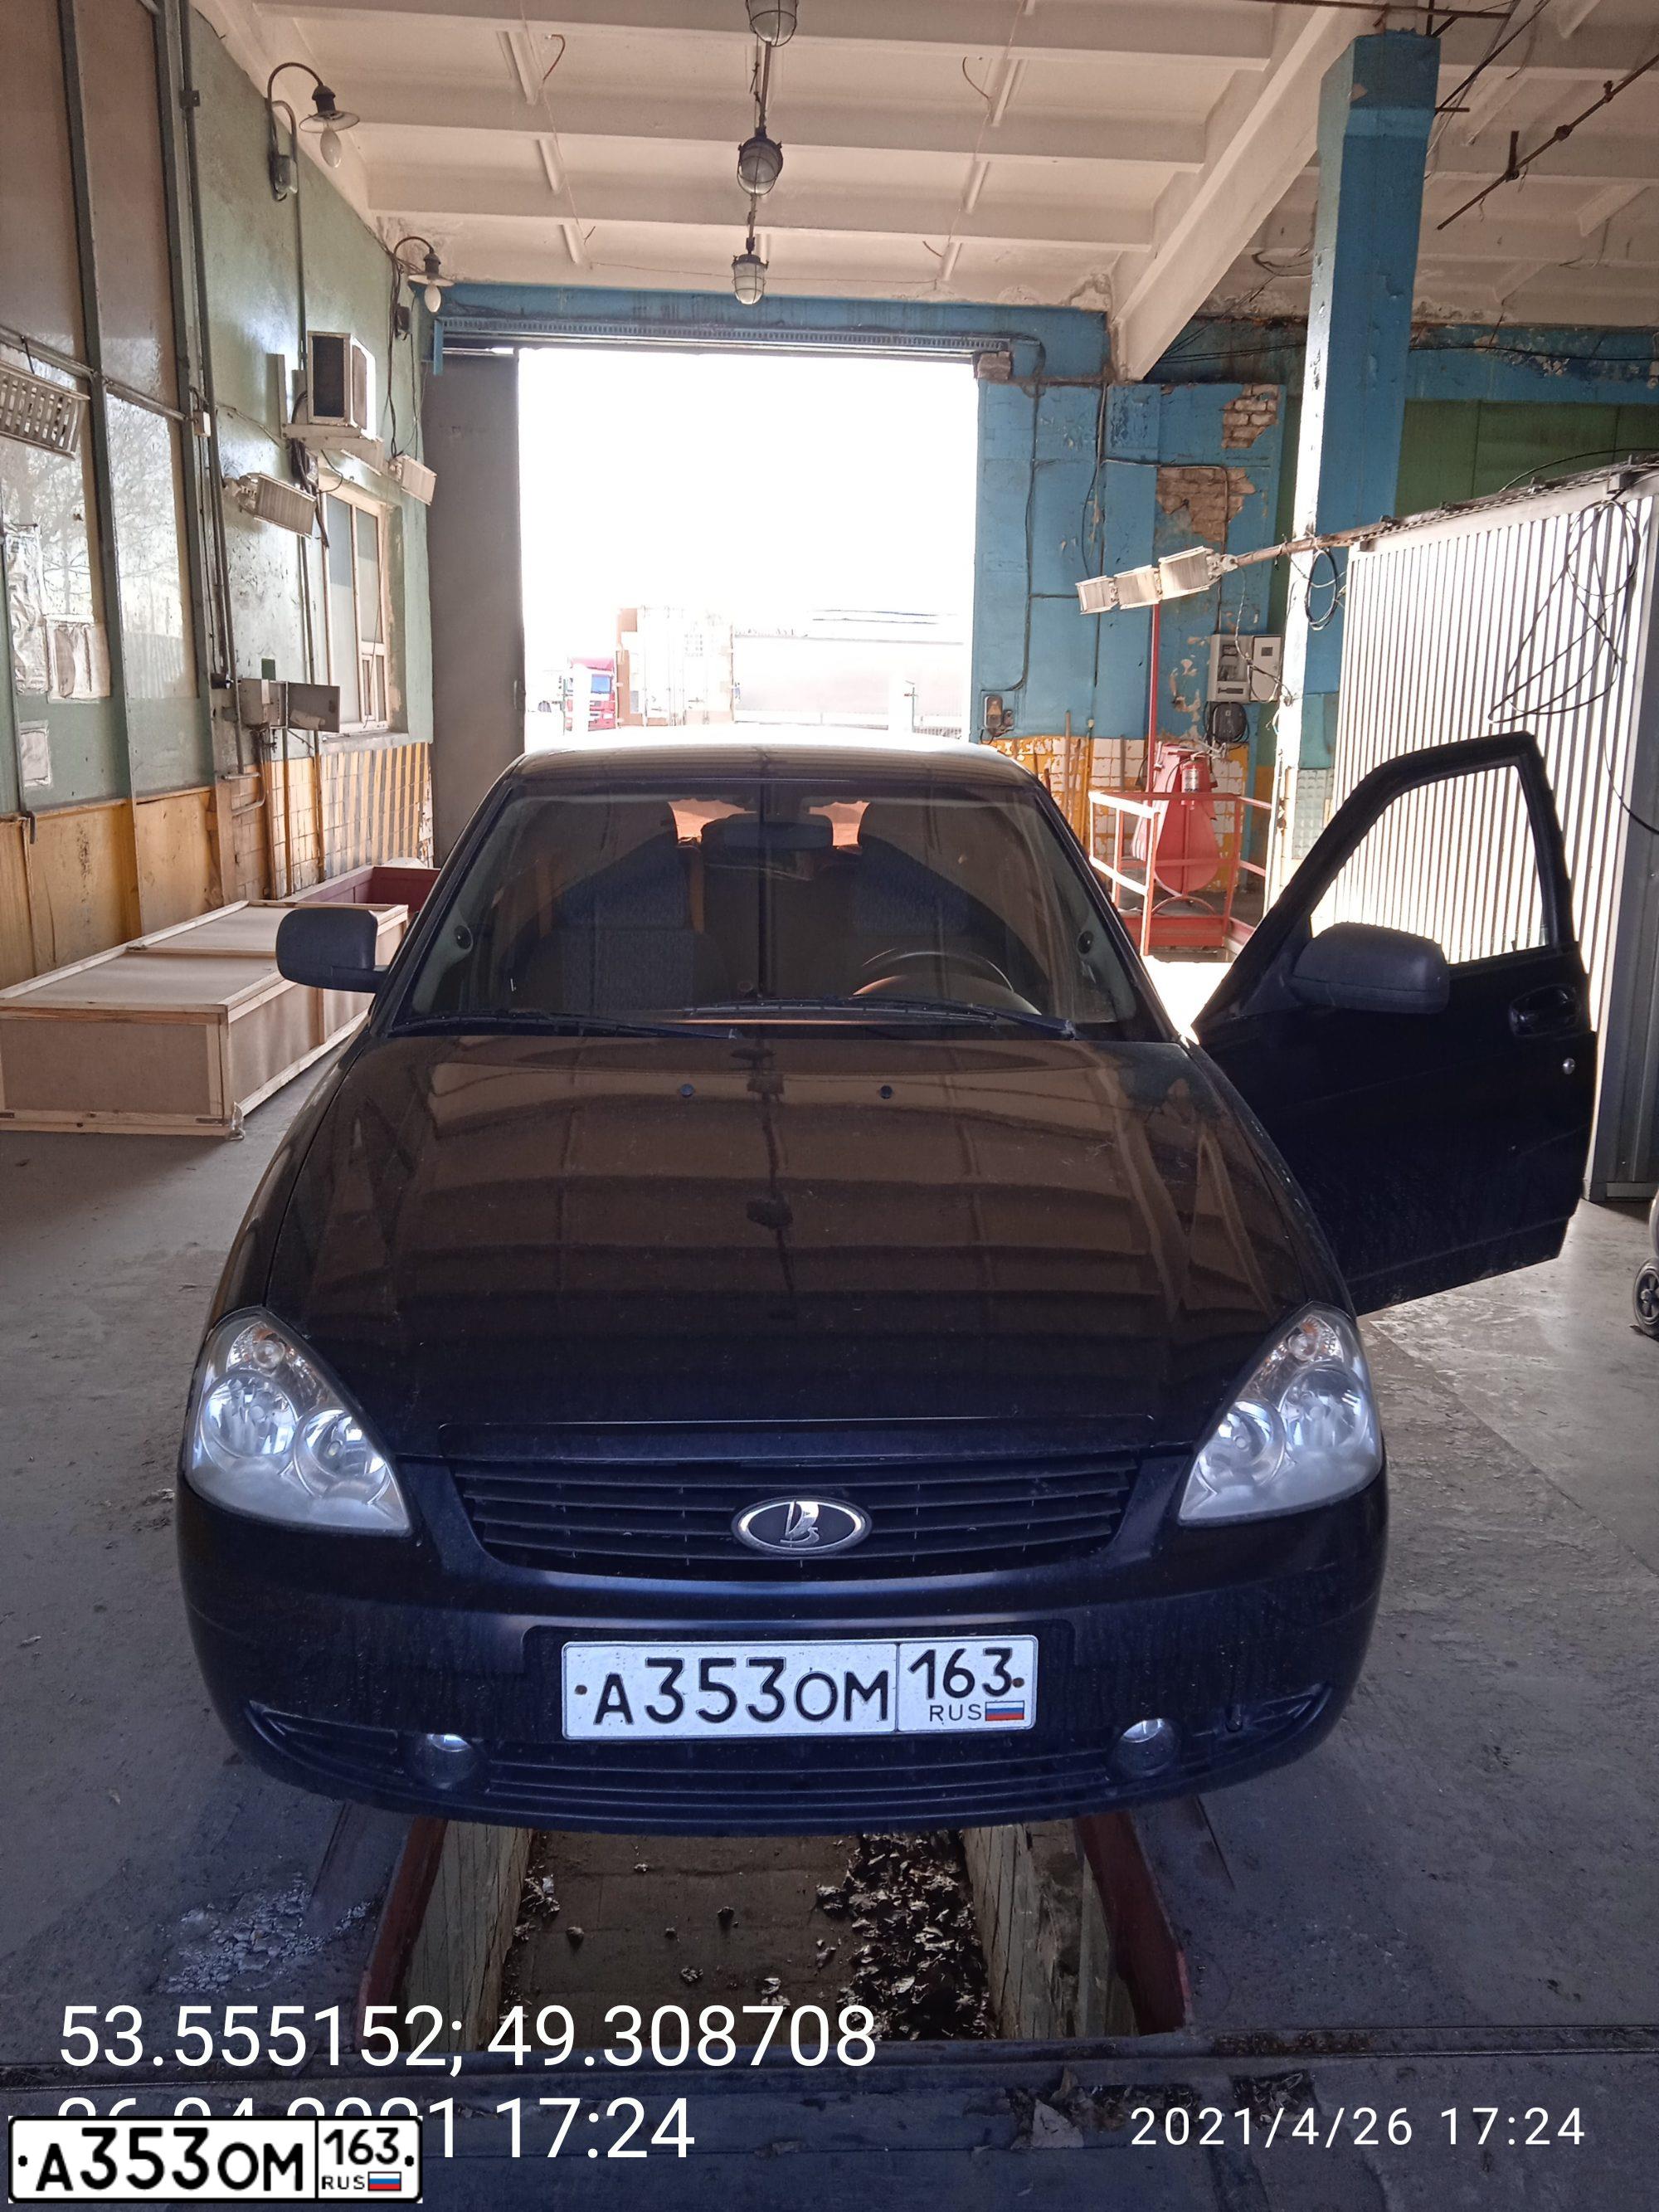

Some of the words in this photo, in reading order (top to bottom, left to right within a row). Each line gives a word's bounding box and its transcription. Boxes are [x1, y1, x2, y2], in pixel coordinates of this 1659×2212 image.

[592, 1657, 889, 1724] А353ОМ
[909, 1648, 1014, 1699] 163
[929, 1703, 981, 1722] RUS
